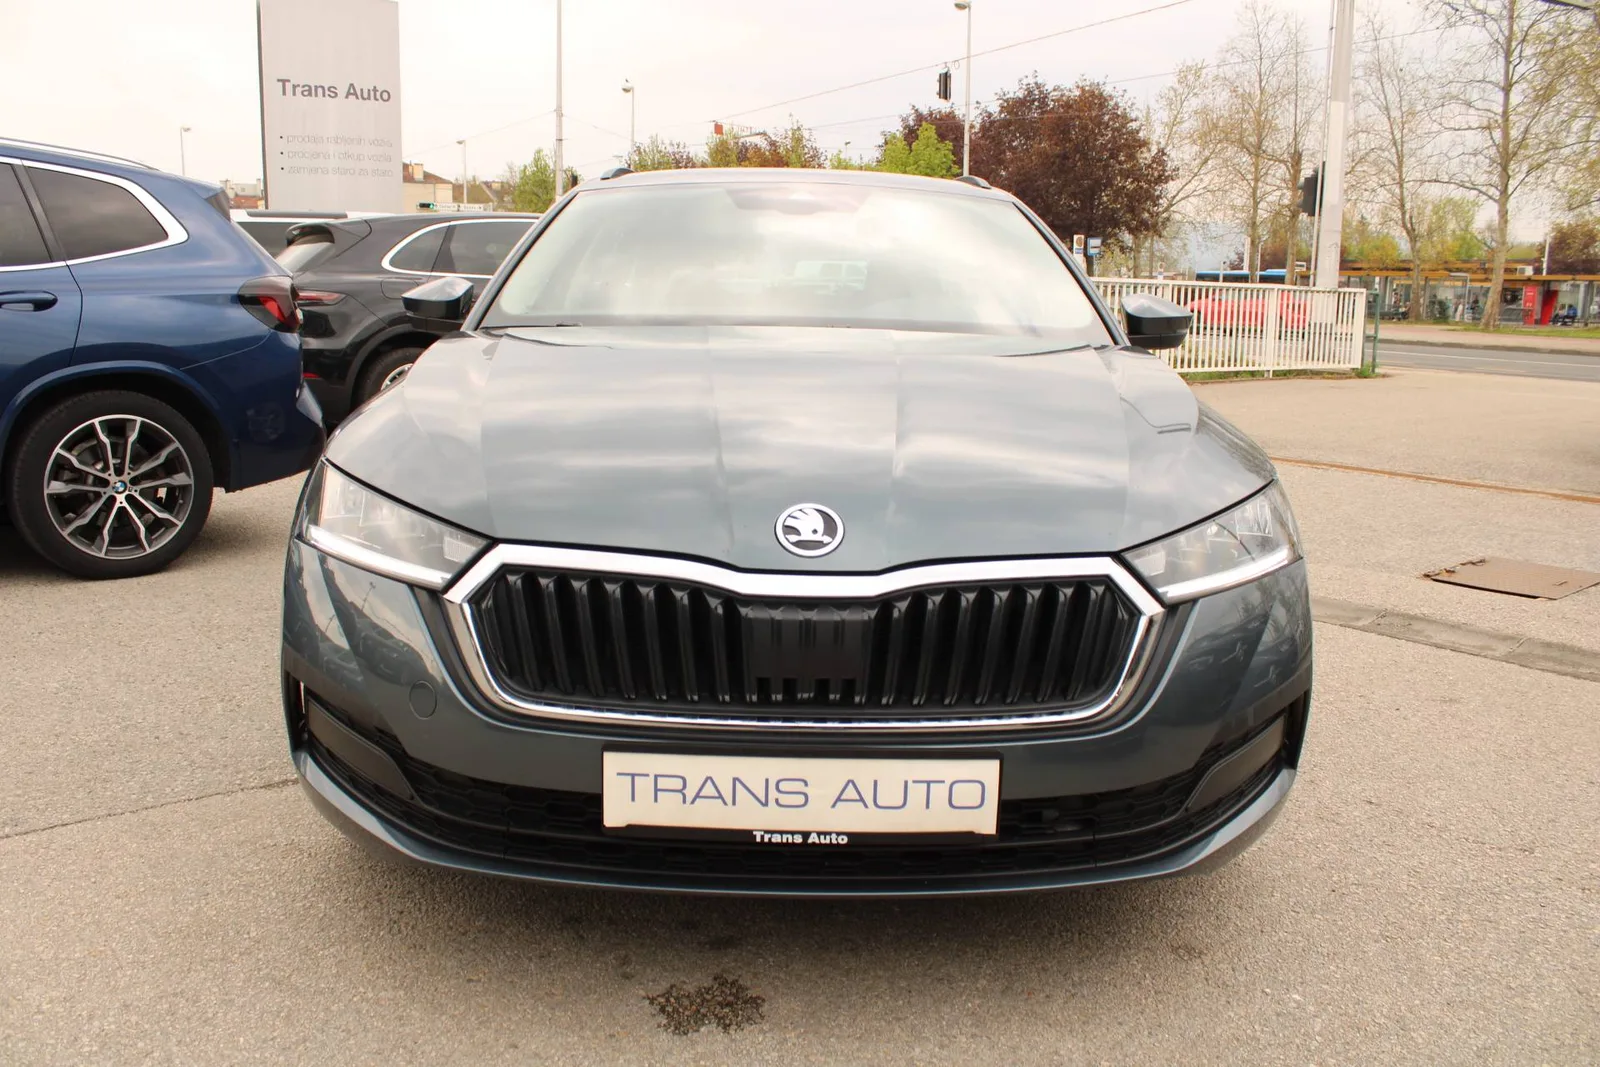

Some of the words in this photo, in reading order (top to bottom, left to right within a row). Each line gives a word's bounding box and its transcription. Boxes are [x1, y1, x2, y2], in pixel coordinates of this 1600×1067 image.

[276, 78, 338, 99] Trans
[345, 82, 392, 103] Auto
[616, 772, 810, 809] TRANS
[831, 779, 986, 811] AUTO
[752, 830, 804, 844] Trans
[807, 832, 849, 846] Auto
